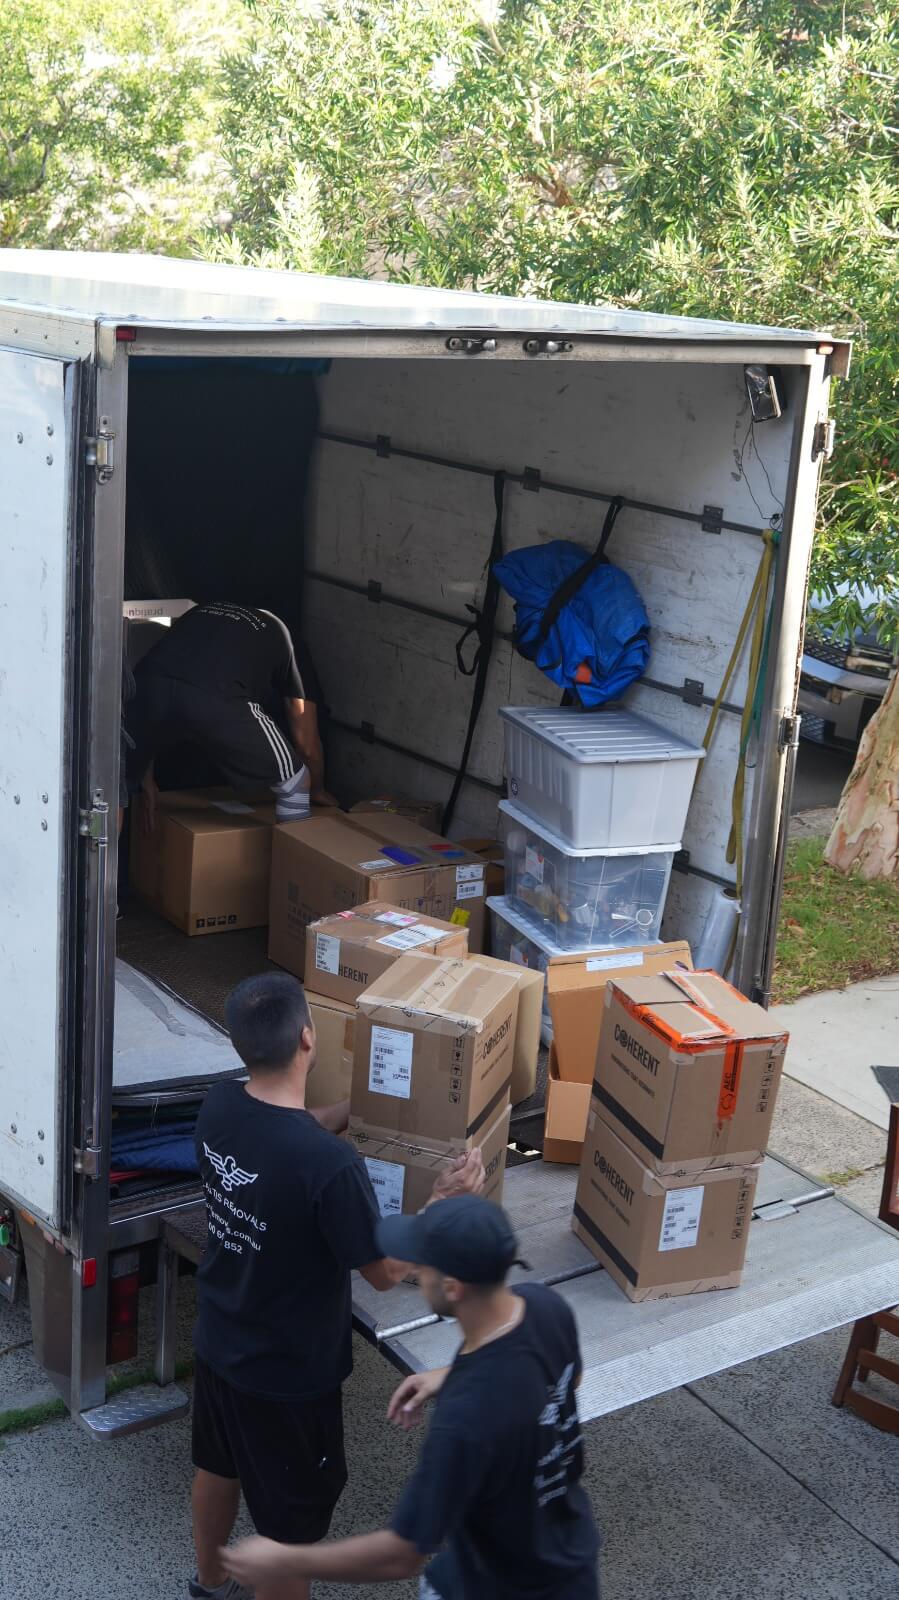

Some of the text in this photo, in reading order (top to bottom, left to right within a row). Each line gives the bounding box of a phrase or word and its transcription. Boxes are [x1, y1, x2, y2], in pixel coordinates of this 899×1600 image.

[338, 965, 369, 985] HERENT
[614, 1023, 660, 1076] COHERENT
[593, 1150, 635, 1206] COHERENT
[223, 1197, 267, 1231] REMOVALS
[224, 1240, 243, 1255] 852
